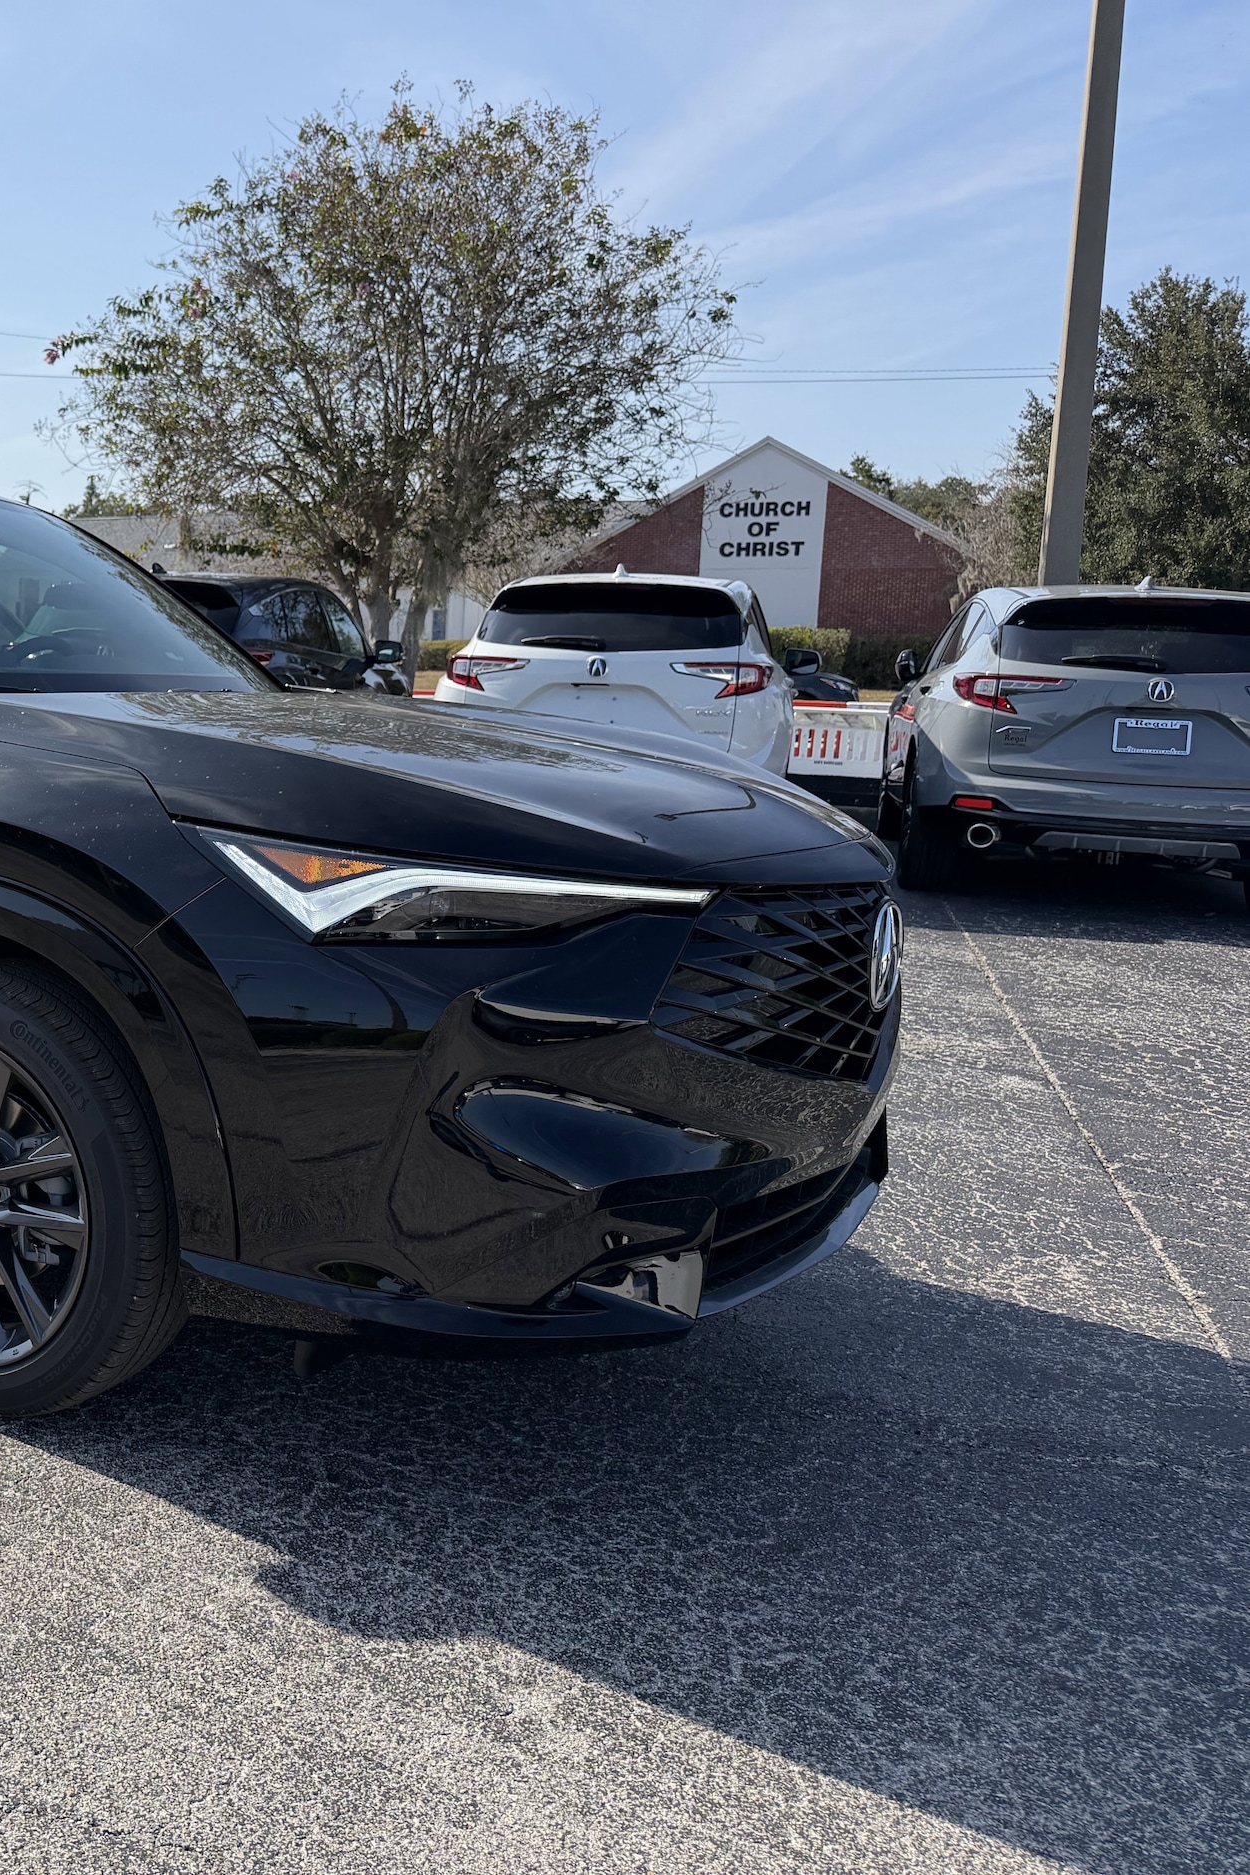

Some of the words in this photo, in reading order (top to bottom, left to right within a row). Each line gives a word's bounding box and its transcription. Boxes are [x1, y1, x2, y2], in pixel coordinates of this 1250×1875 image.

[719, 501, 811, 518] CHURCH
[747, 522, 780, 537] OF
[719, 541, 805, 557] CHRIST
[1135, 720, 1174, 729] Regal
[1004, 734, 1028, 743] Regal
[9, 1020, 84, 1101] Continental
